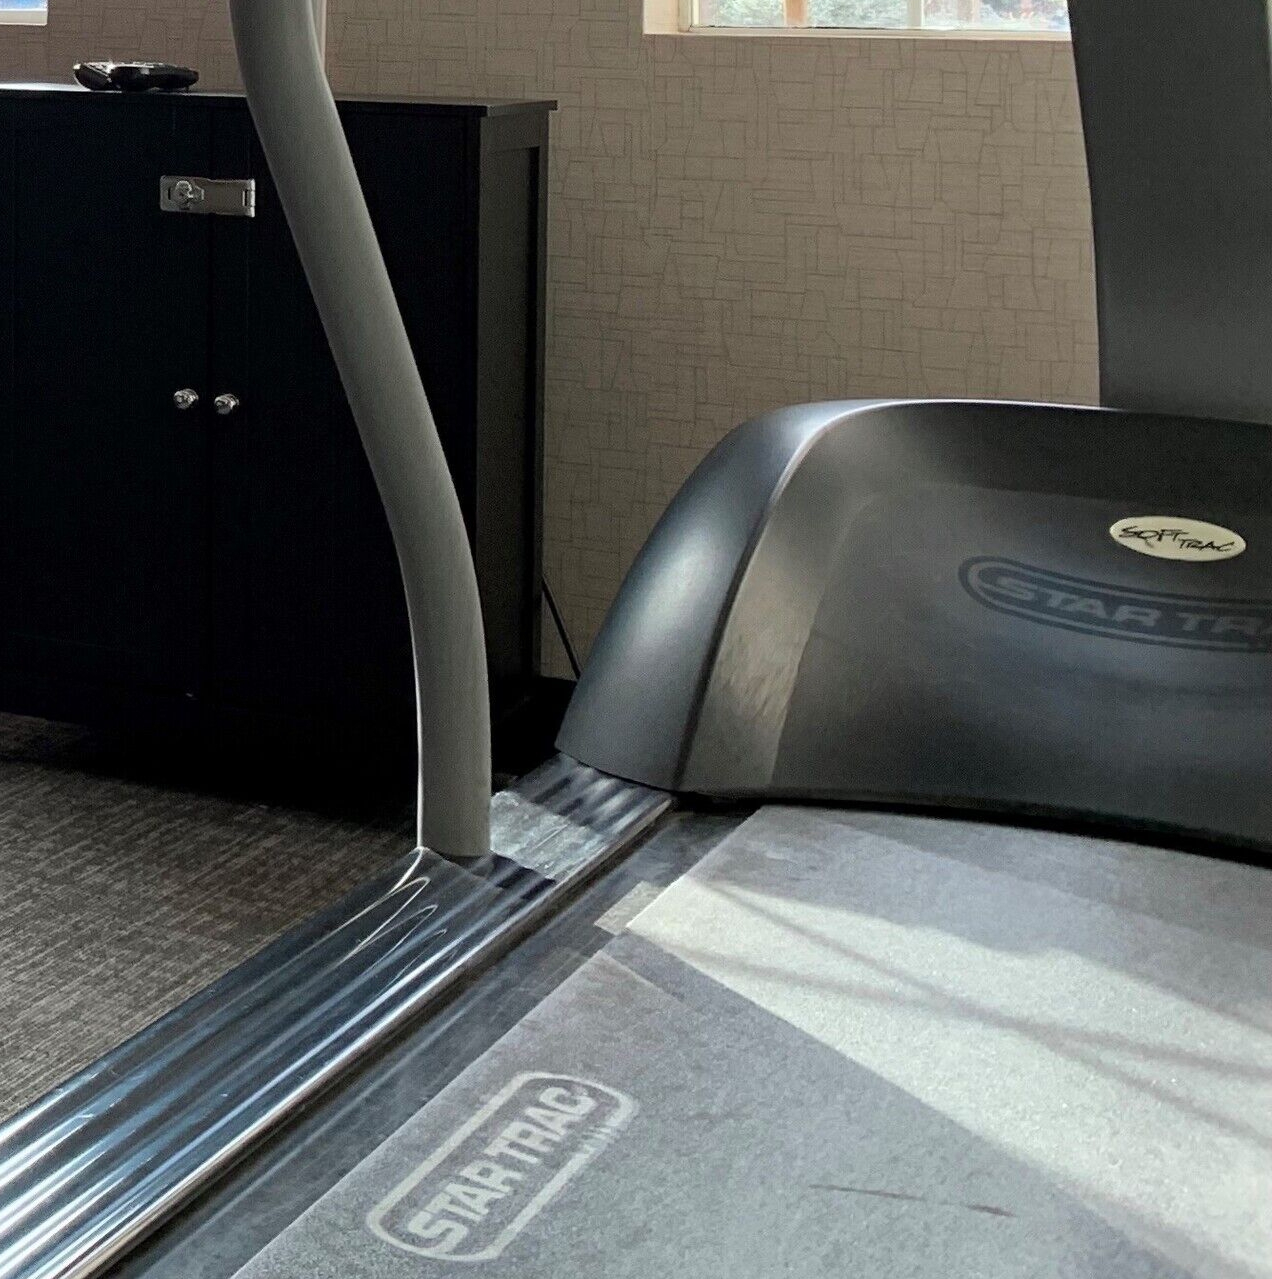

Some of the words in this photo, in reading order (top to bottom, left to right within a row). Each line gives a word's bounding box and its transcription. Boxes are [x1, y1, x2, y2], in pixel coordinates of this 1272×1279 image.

[996, 576, 1163, 627] STAR
[407, 1160, 527, 1255] STAR
[483, 1086, 598, 1164] TRAC
